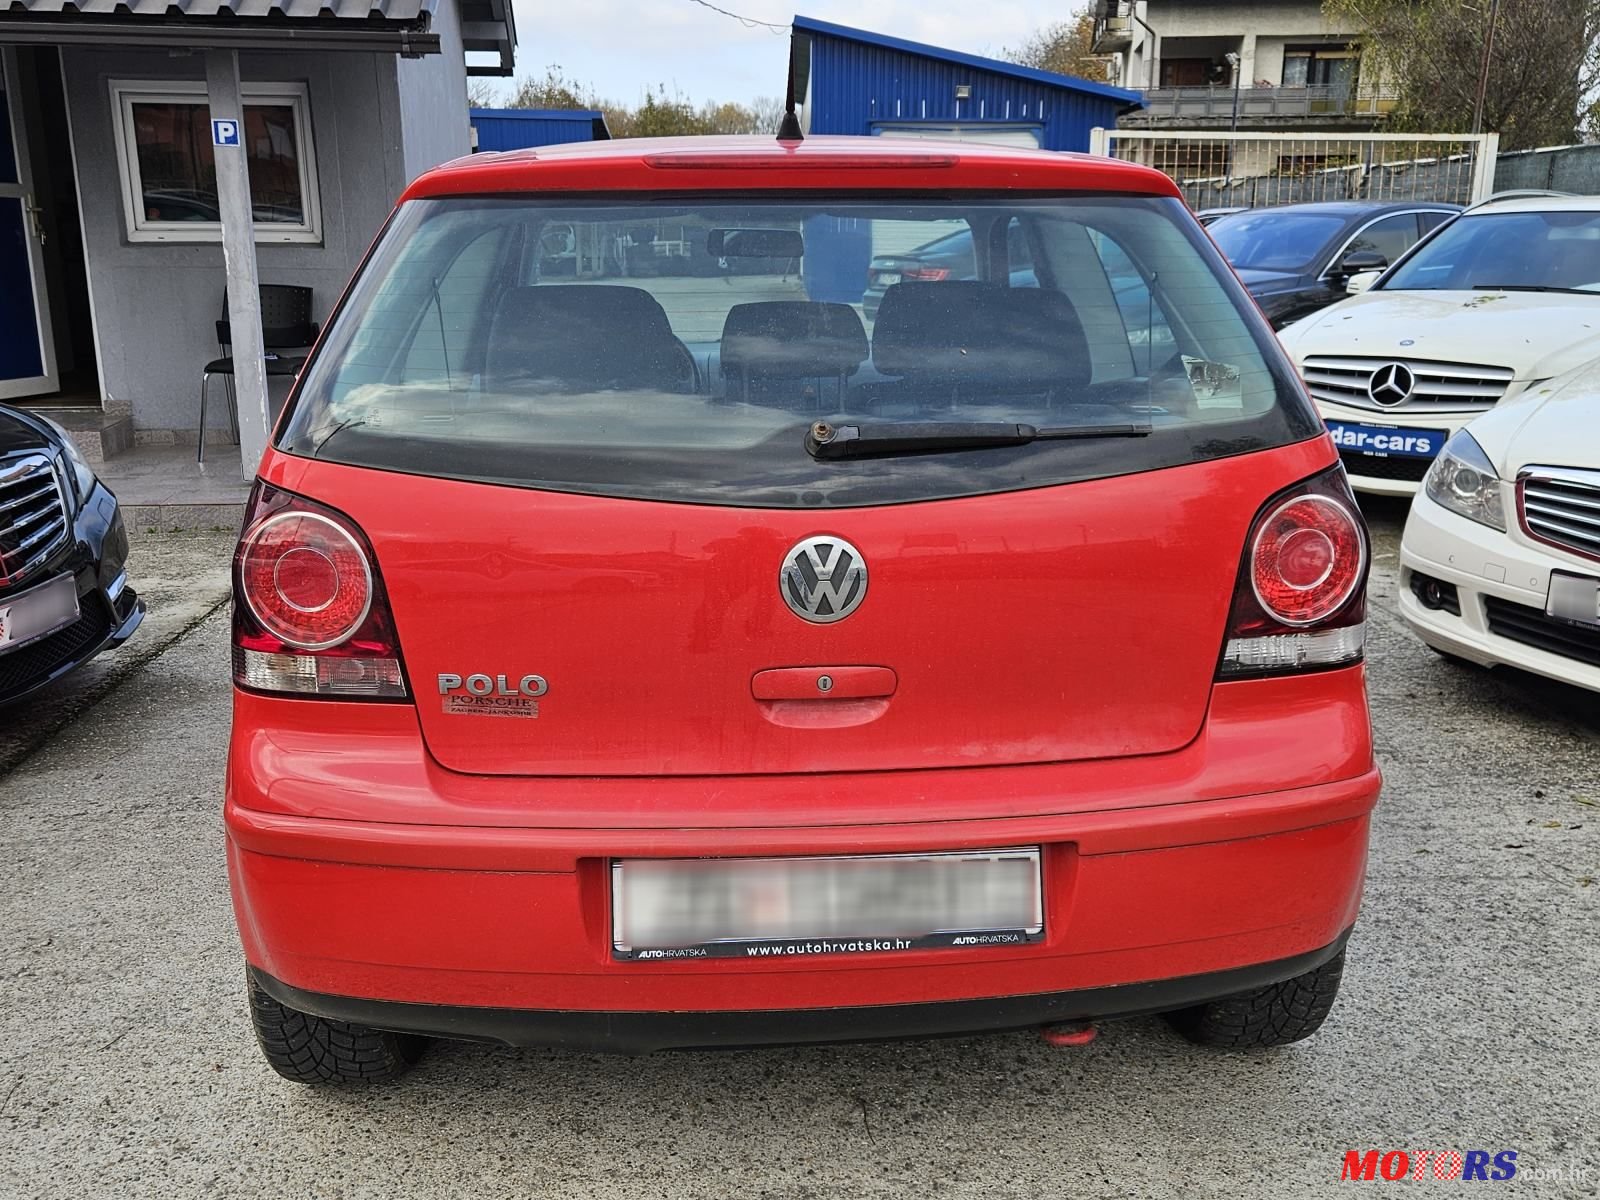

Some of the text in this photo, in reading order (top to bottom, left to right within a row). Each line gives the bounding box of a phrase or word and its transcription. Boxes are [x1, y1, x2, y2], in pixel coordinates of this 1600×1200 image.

[217, 122, 235, 144] P
[438, 673, 548, 697] POLO
[451, 695, 532, 707] PORSCHE
[952, 934, 1019, 945] AUTOHRVATSKA
[638, 948, 707, 959] AUTOHRVATSKA
[746, 939, 911, 956] www.autohrvatska.hr
